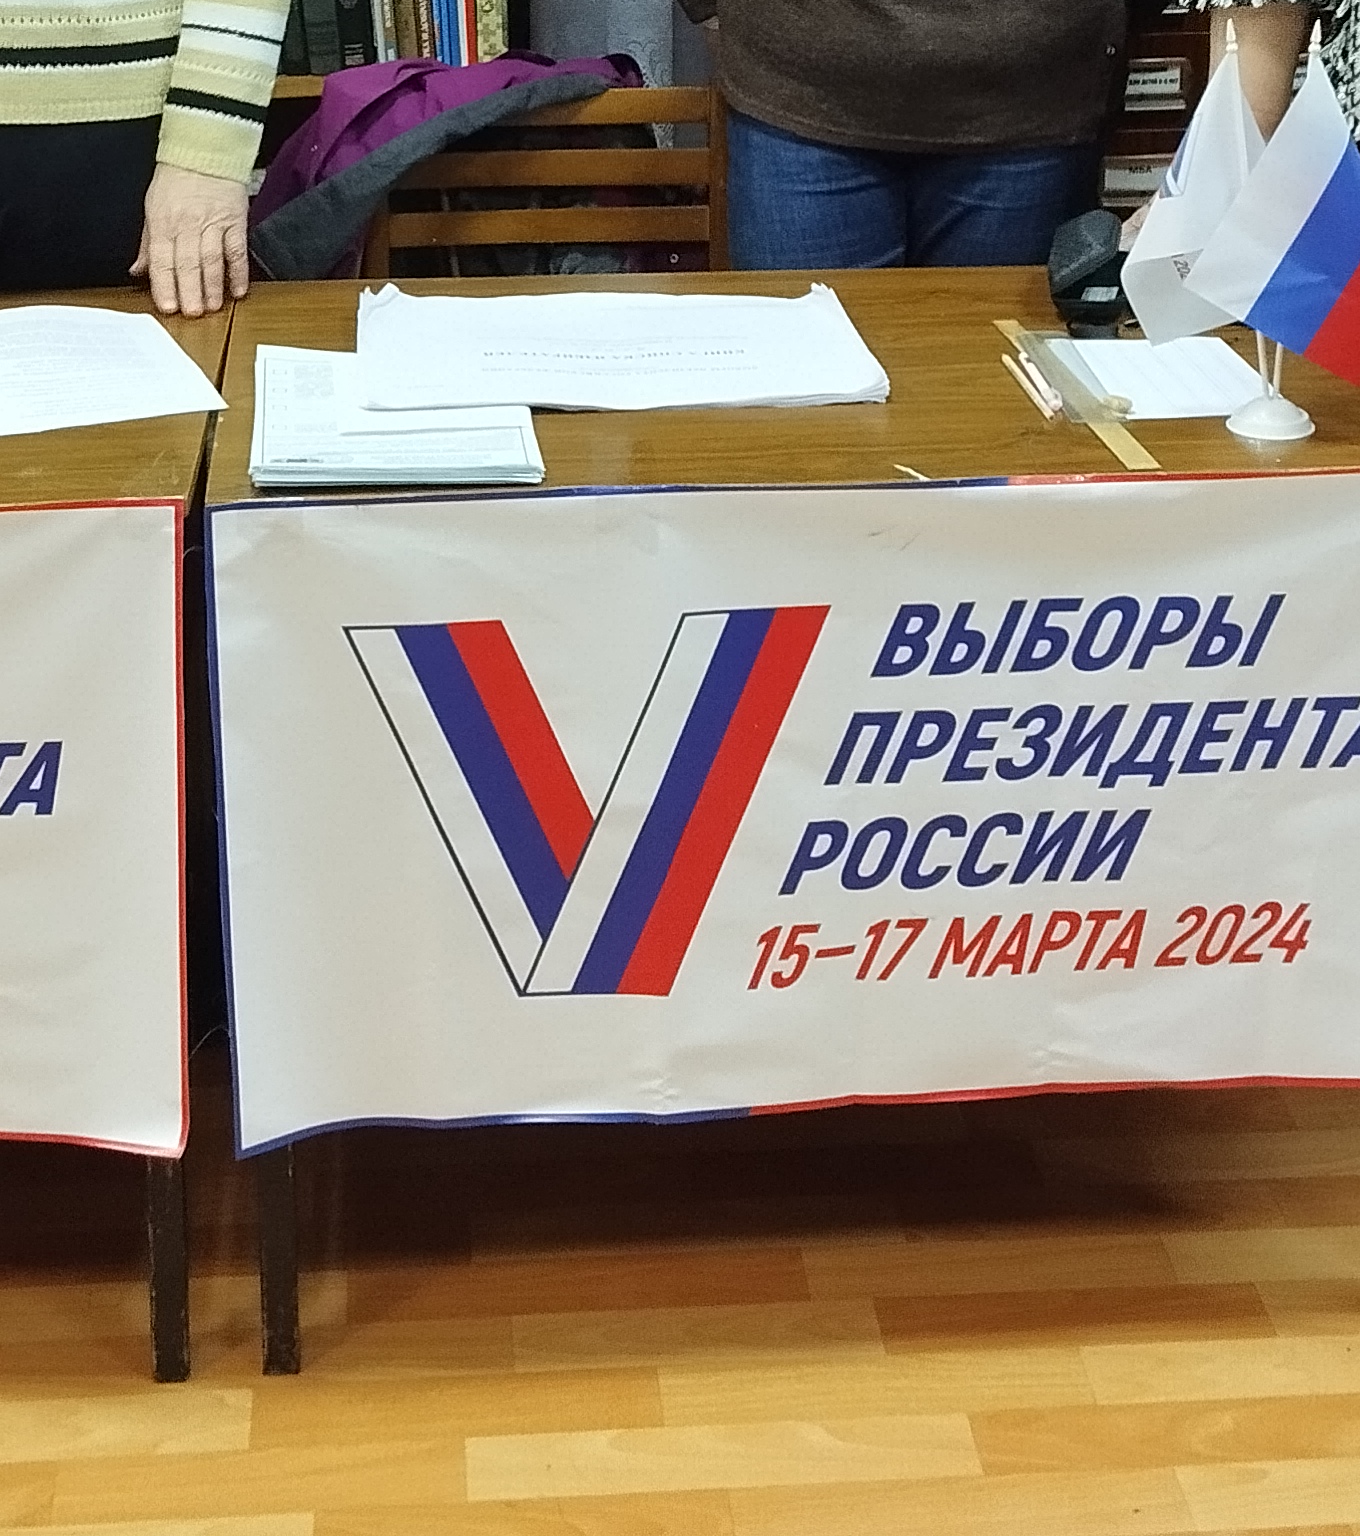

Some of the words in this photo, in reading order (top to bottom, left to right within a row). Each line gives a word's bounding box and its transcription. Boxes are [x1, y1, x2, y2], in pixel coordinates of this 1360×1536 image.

[870, 593, 1287, 679] ВЫБОРЫ
[778, 808, 1152, 896] РОССИИ
[928, 908, 1148, 980] МАРТА
[1153, 901, 1313, 968] 2024
